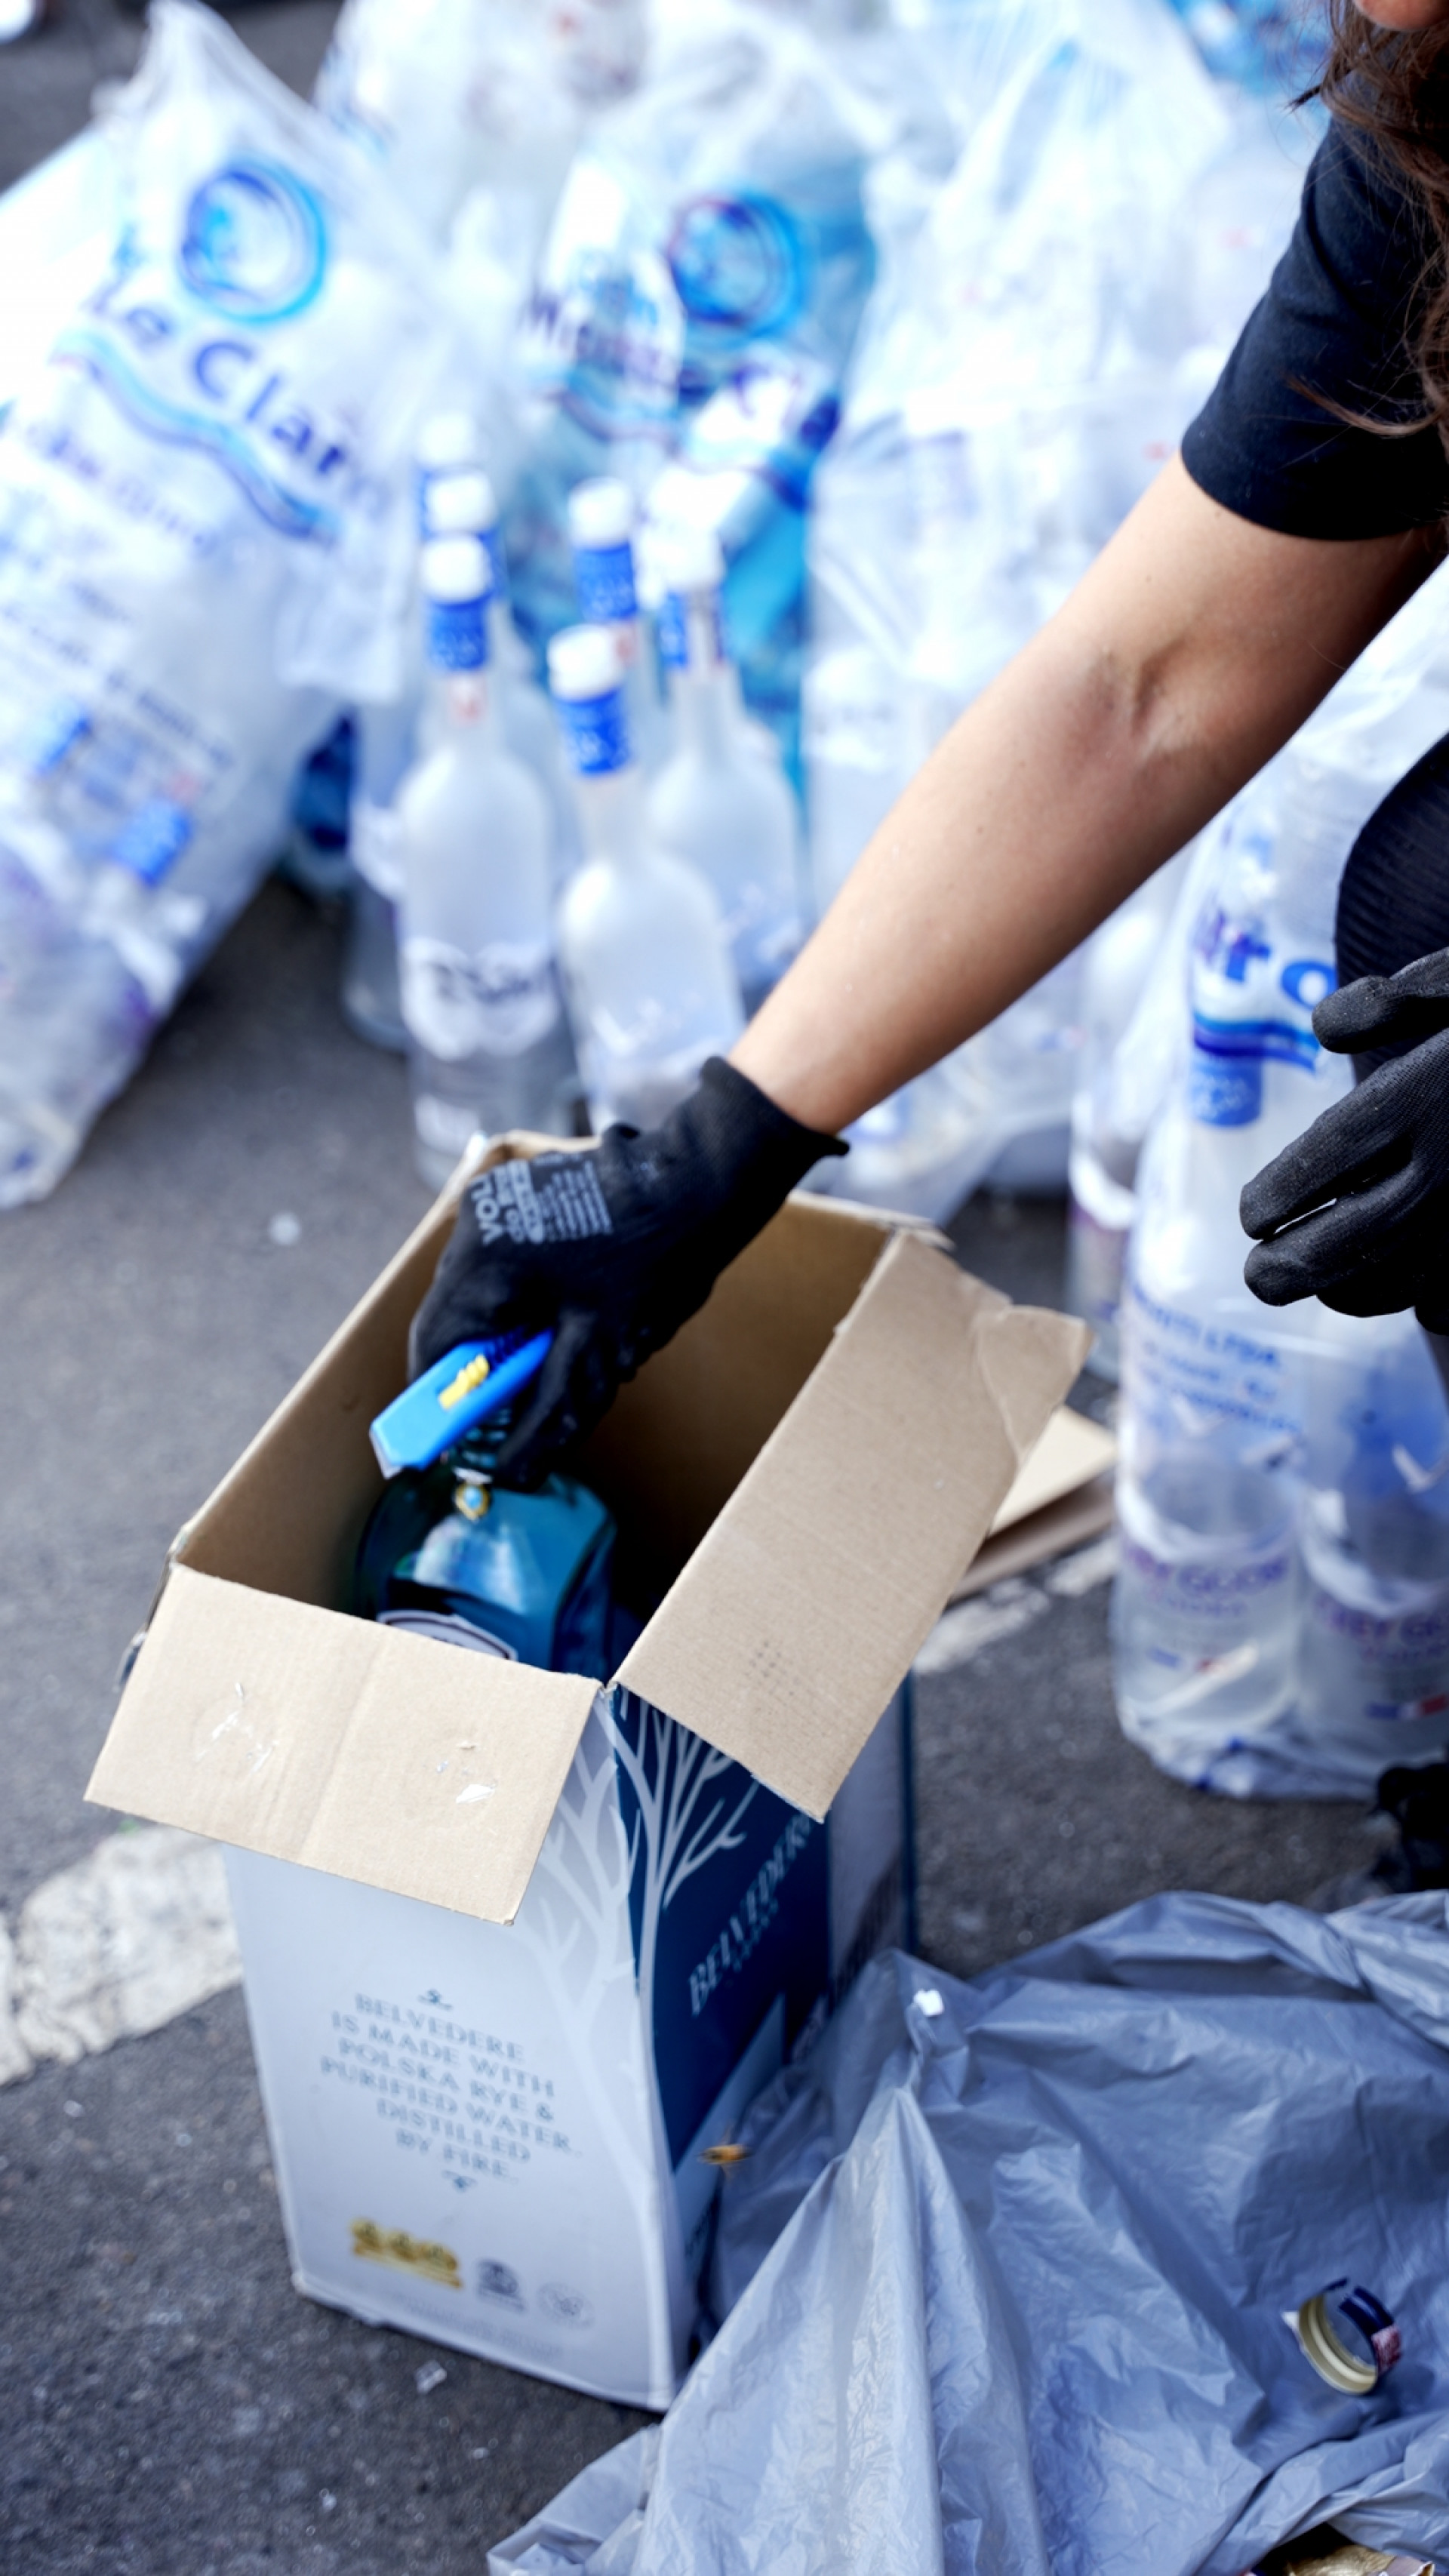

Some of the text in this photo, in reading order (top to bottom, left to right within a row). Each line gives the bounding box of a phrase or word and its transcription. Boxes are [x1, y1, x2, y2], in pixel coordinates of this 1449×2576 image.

[331, 2010, 555, 2099] IS MADE WITH
[355, 1991, 526, 2064] BELVEDERE
[320, 2054, 458, 2117] PURIFIED
[338, 2037, 554, 2123] POLSKA RYE &
[377, 2096, 531, 2164] DISTILLED
[395, 2127, 432, 2156] BY
